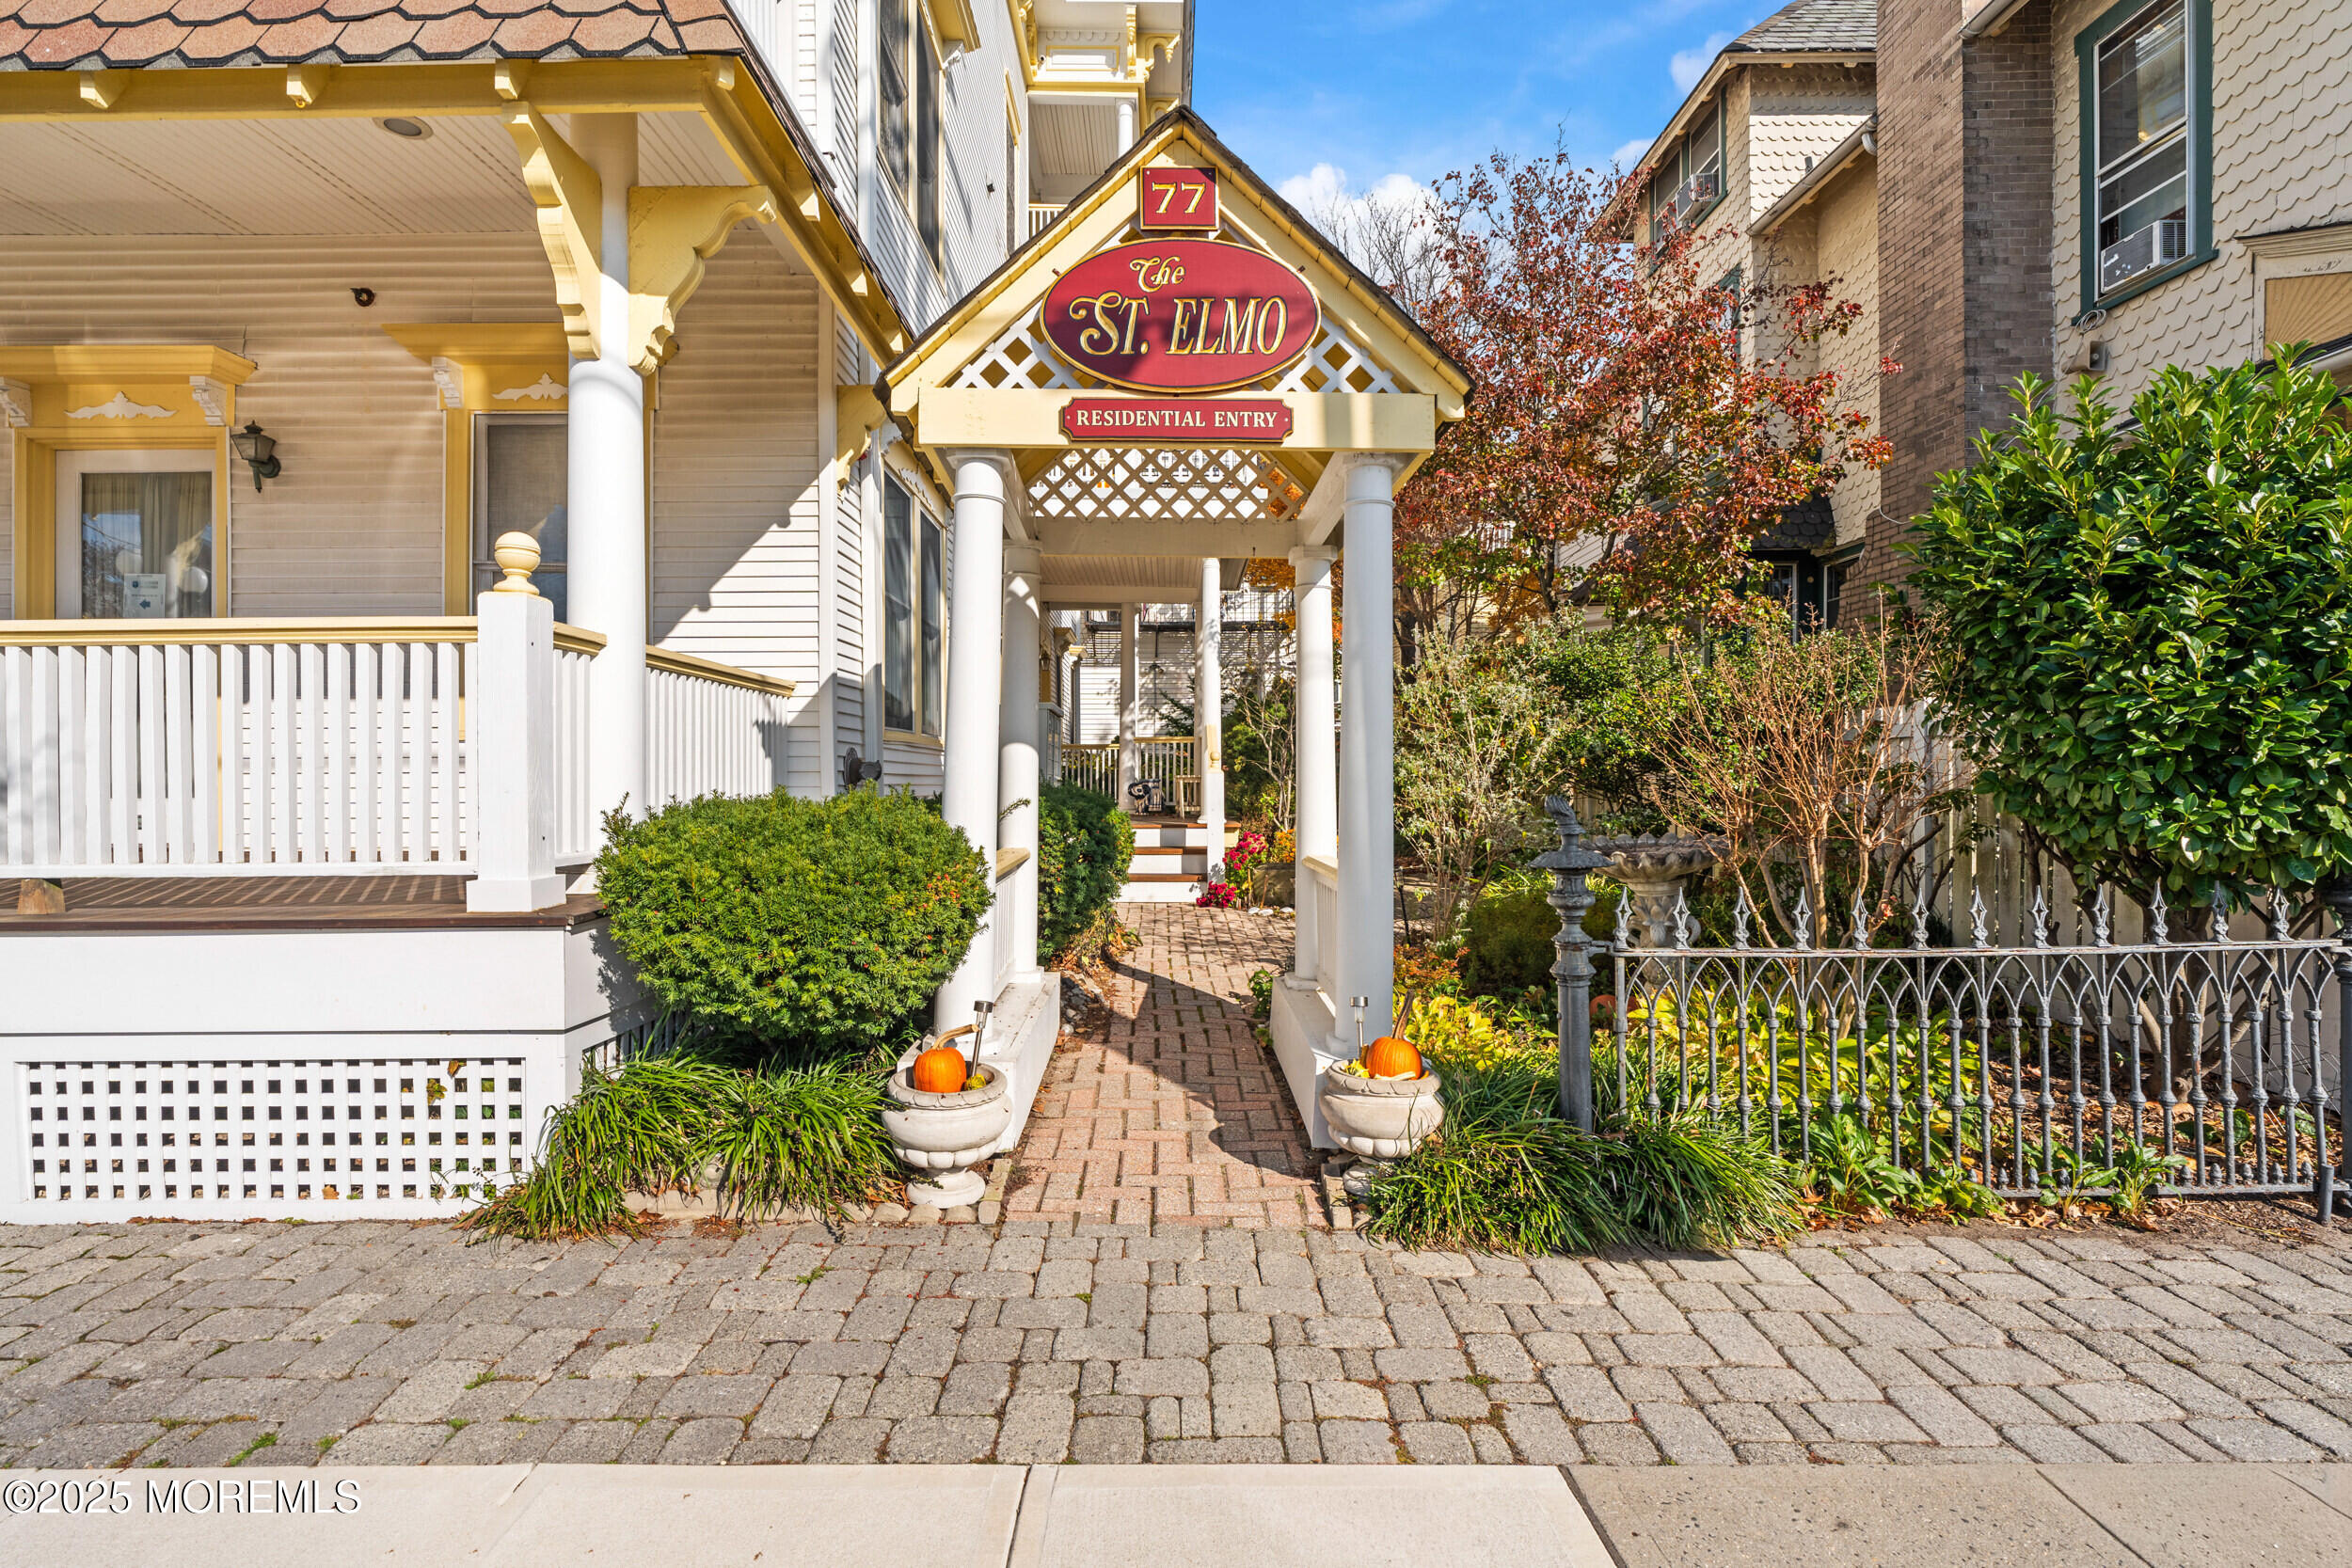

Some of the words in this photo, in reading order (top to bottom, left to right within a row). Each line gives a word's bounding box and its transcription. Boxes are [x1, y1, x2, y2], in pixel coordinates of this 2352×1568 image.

[1151, 182, 1207, 214] 77
[1129, 255, 1187, 293] The
[1069, 291, 1151, 356] ST.
[1165, 295, 1289, 356] ELMO
[1075, 409, 1206, 428] RESIDENTIAL
[1214, 410, 1279, 429] ENTRY
